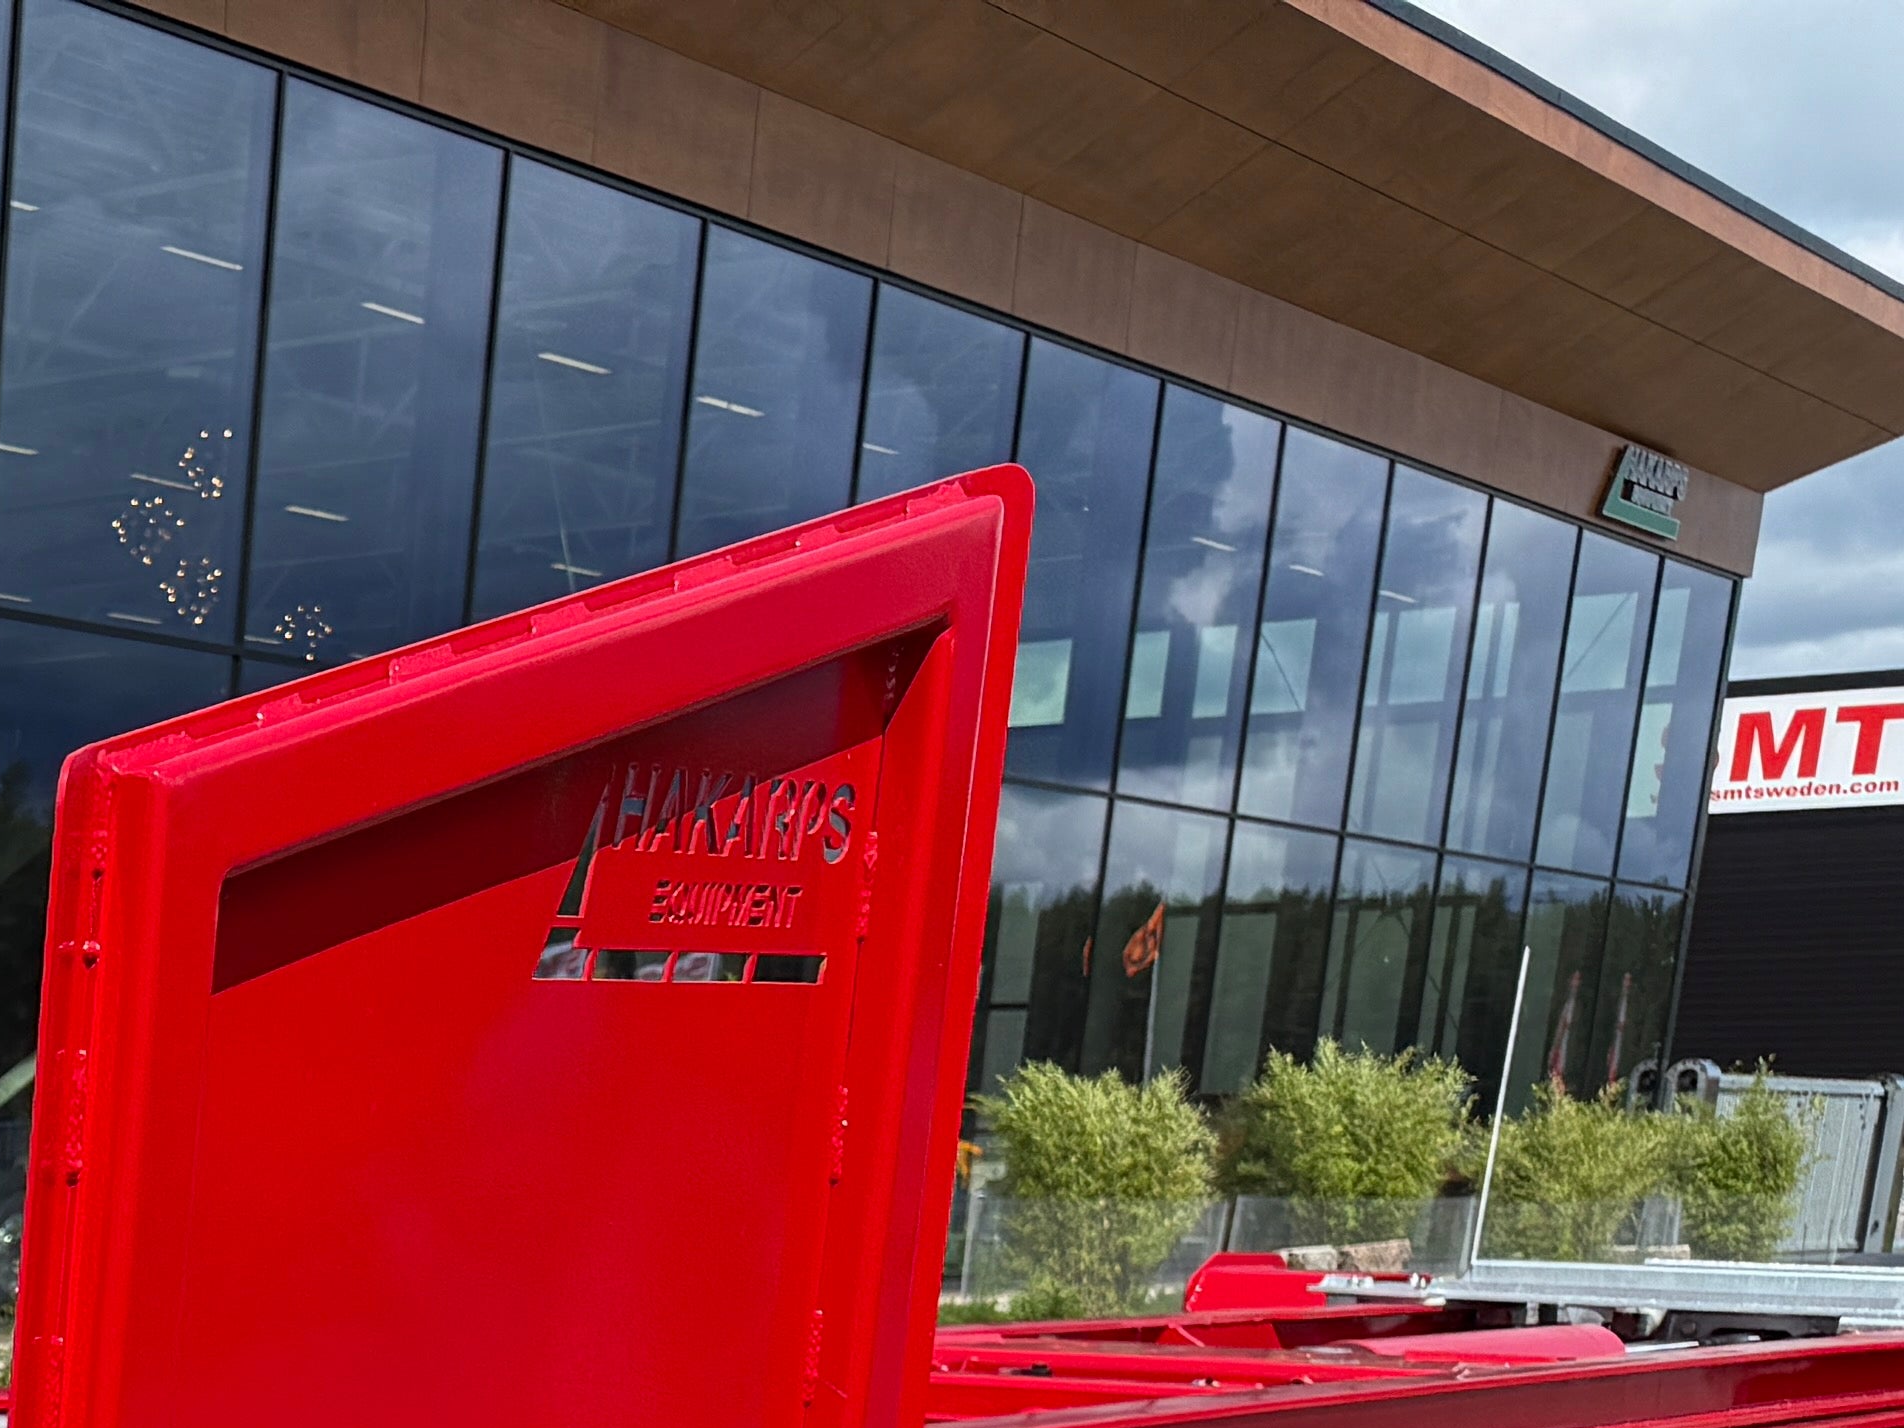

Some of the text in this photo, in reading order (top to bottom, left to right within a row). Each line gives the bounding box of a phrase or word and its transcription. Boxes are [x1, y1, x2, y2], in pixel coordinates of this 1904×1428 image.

[1714, 703, 1904, 782] MT
[611, 761, 857, 864] HAKARPS
[647, 879, 804, 928] EQUIPMENT
